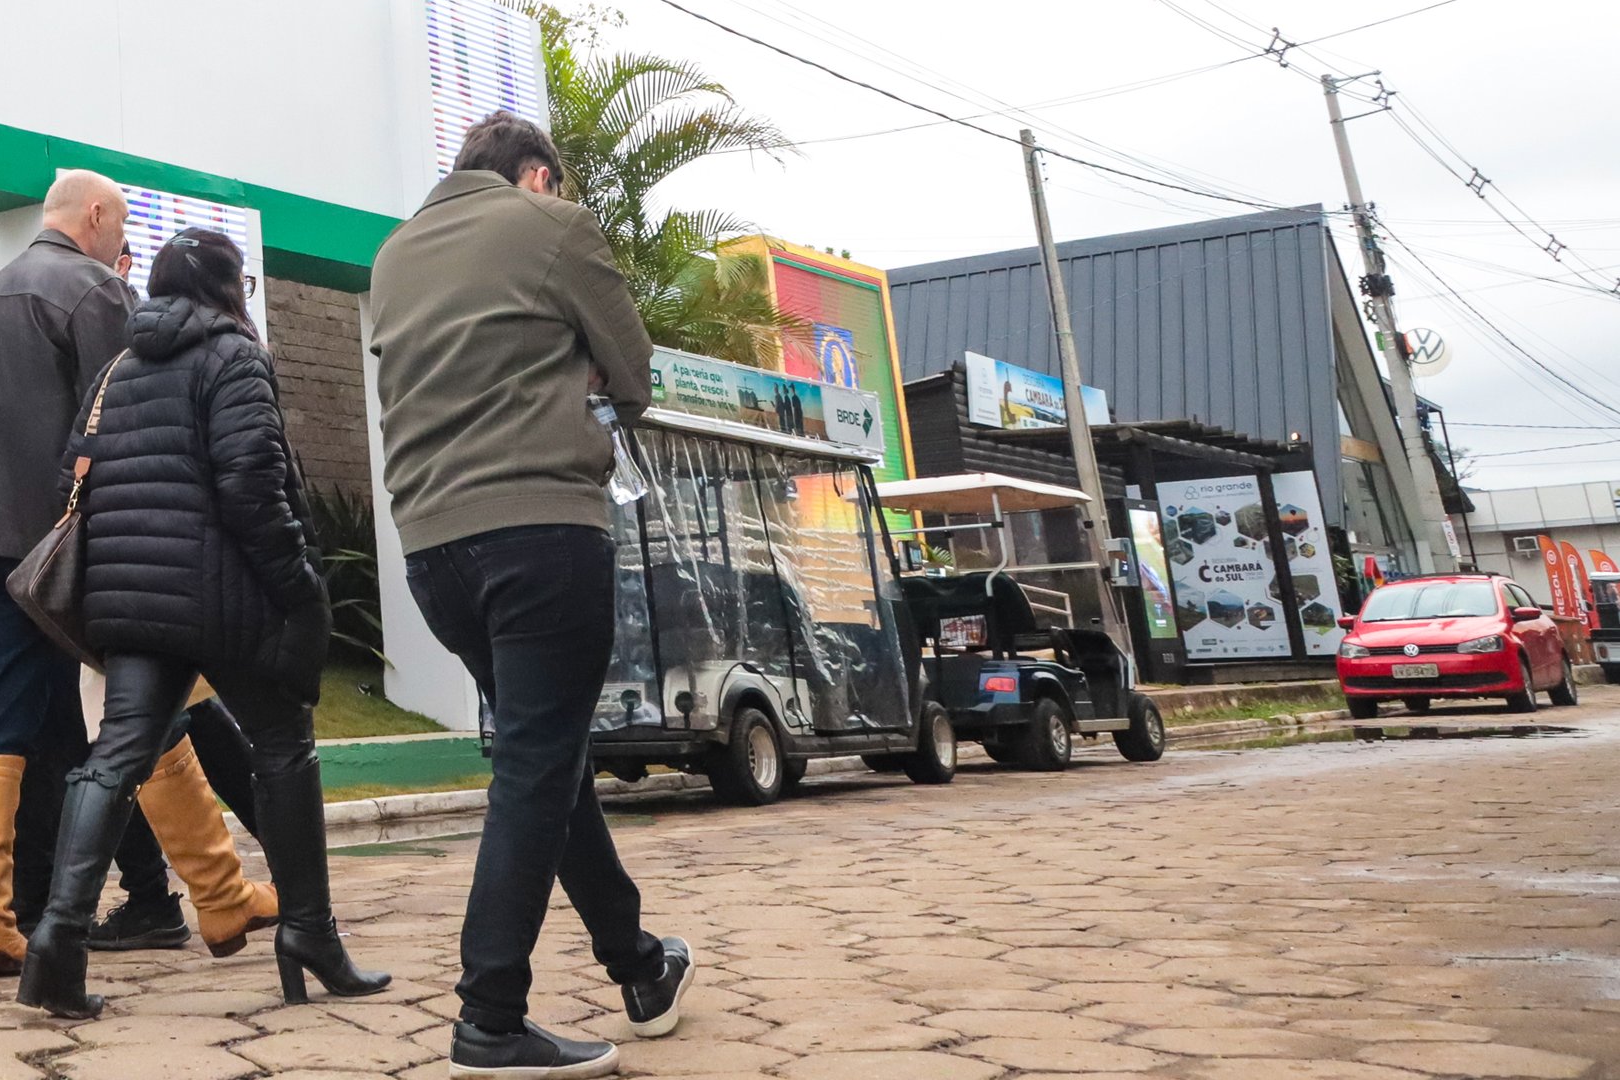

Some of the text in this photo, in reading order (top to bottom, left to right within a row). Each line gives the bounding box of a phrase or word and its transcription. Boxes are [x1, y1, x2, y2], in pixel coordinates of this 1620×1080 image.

[836, 408, 861, 427] BRDE
[1213, 560, 1263, 574] CAMBARÁ
[1225, 572, 1245, 582] SUL
